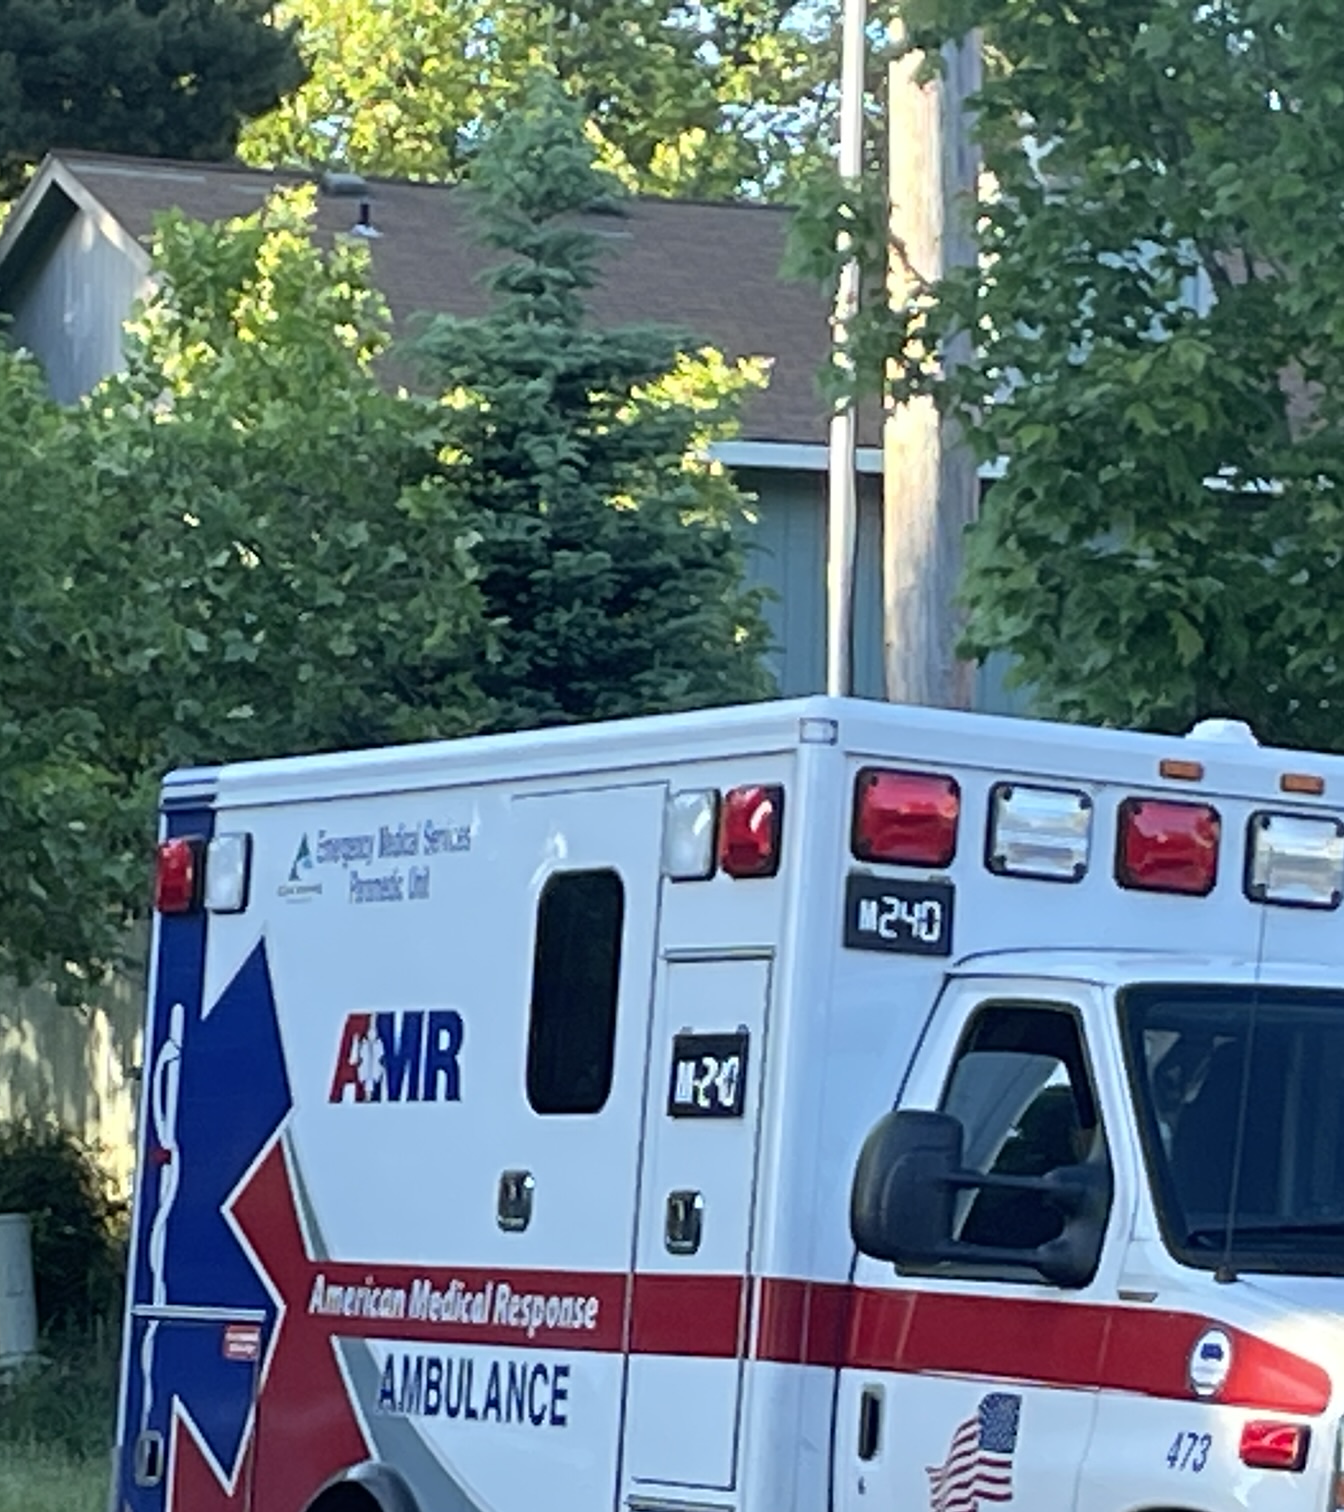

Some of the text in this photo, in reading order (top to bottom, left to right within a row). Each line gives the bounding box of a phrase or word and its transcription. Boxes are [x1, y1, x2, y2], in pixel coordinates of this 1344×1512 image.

[858, 895, 942, 942] M240
[328, 1010, 464, 1104] AMR
[308, 1273, 600, 1339] American Medical Response
[377, 1352, 572, 1428] AMBULANCE
[1166, 1431, 1213, 1474] 473
